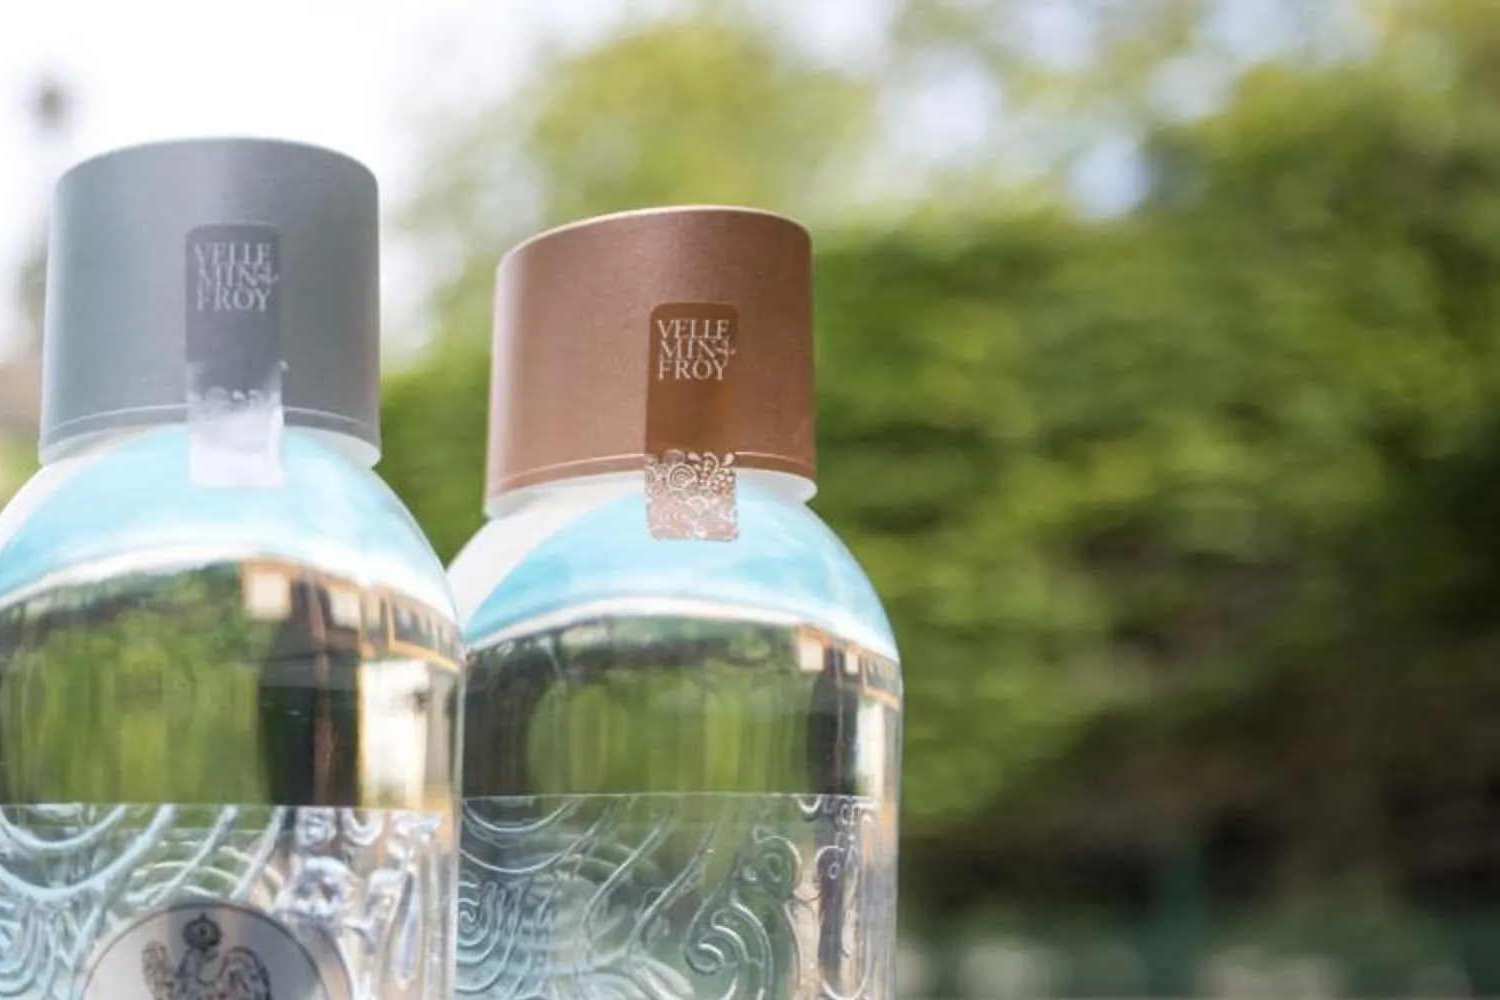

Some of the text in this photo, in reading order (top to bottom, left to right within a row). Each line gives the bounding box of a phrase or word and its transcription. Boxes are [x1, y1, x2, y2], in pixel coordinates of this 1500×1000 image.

[194, 242, 271, 266] VELLE
[195, 286, 273, 312] FROY
[657, 318, 730, 340] VELLE
[657, 359, 729, 381] FROY
